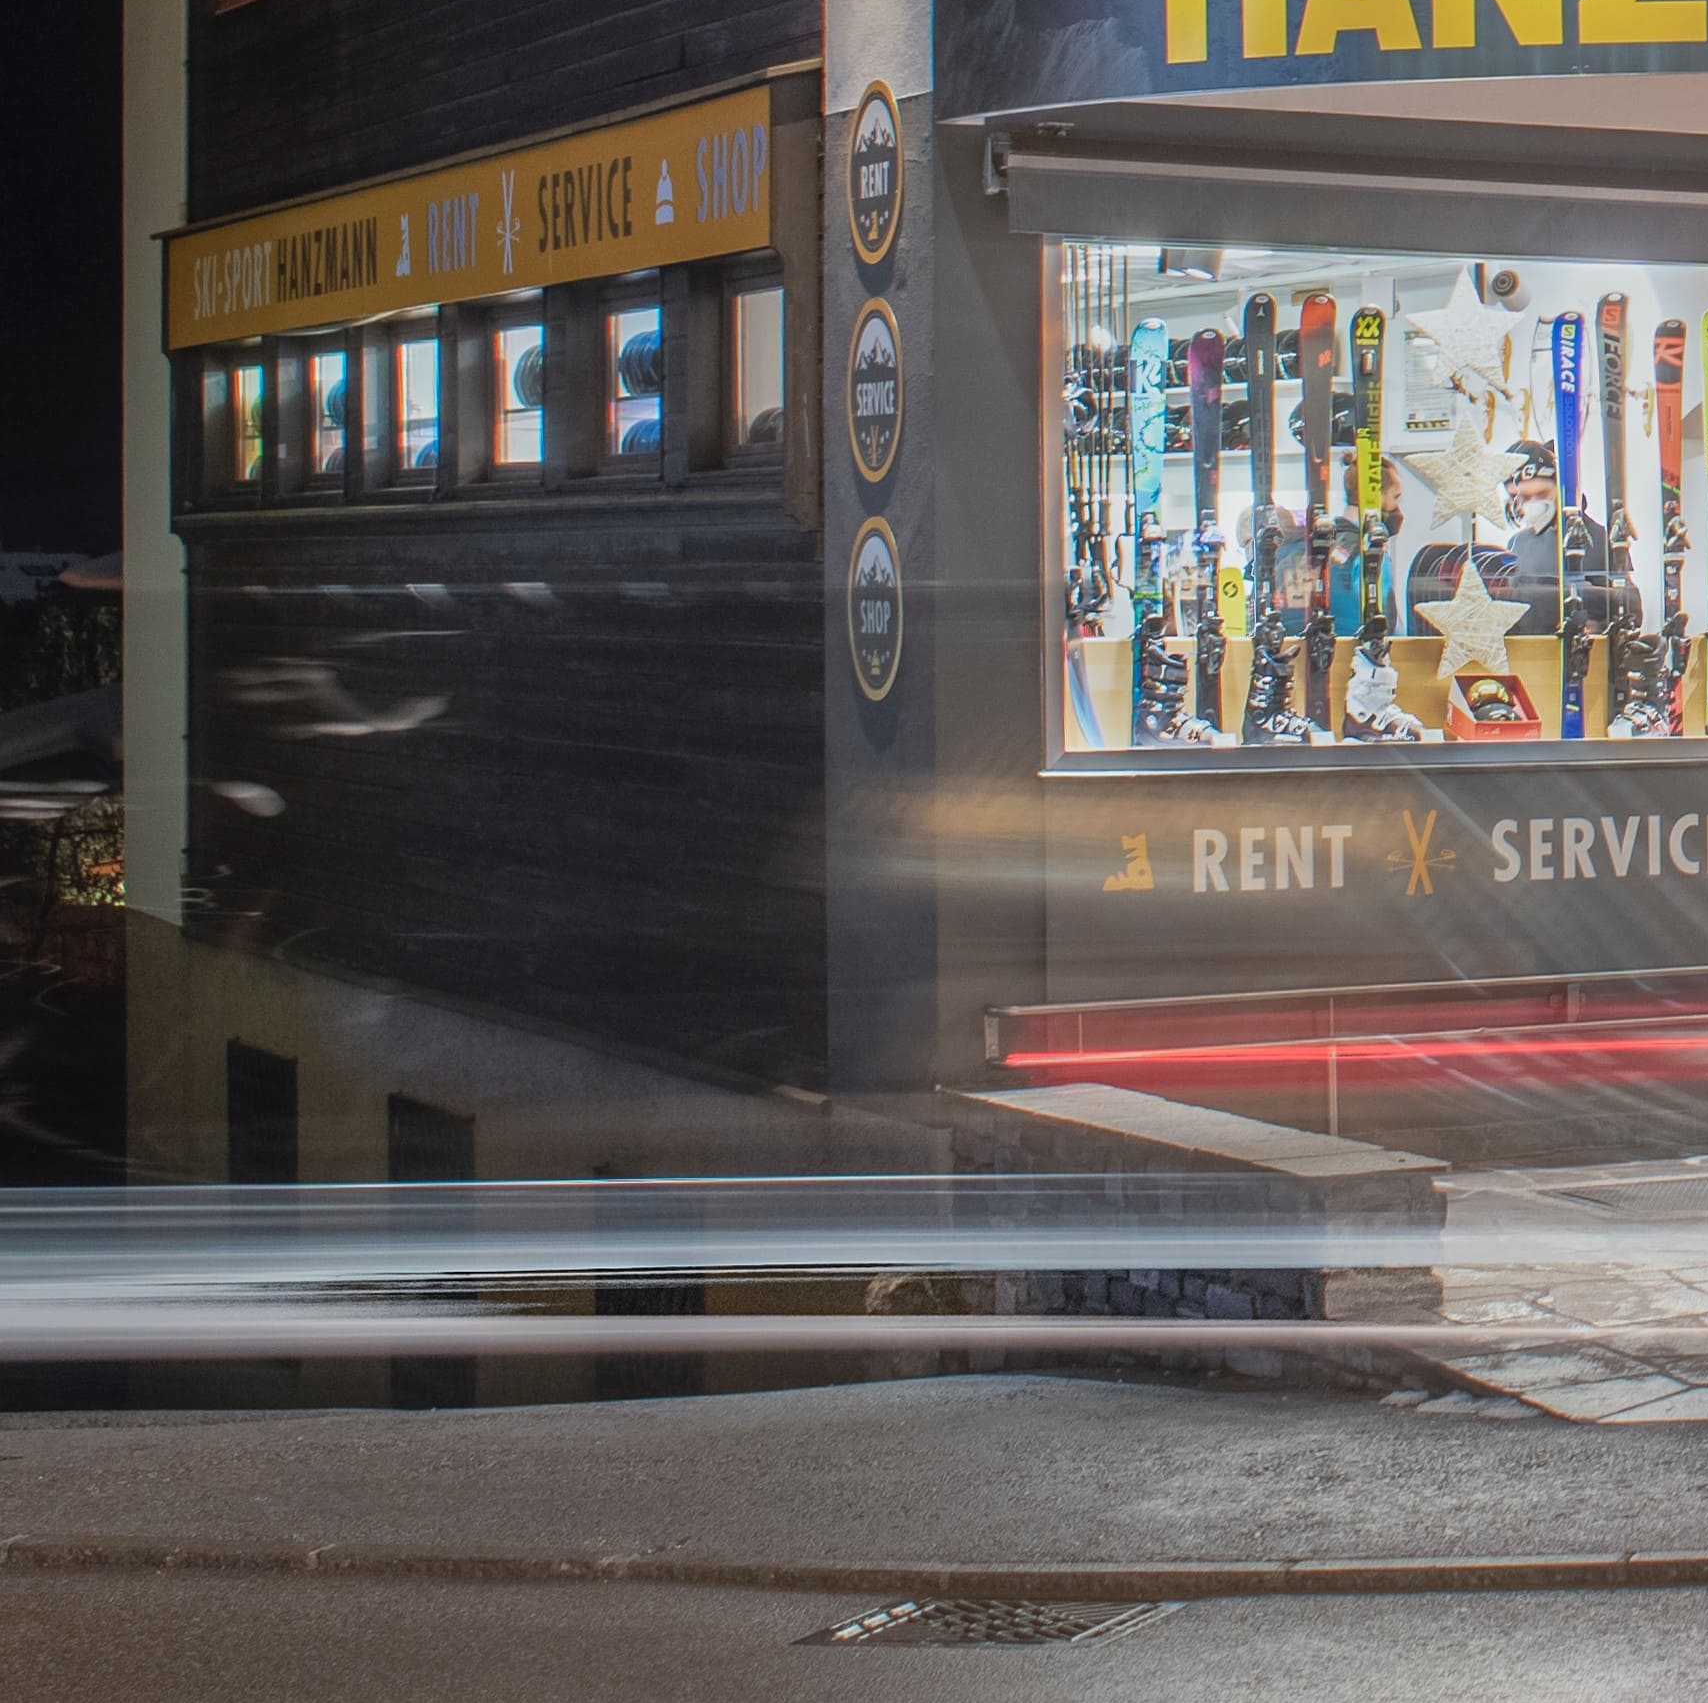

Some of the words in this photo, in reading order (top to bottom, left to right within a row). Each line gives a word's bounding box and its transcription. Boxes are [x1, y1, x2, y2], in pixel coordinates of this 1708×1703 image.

[860, 160, 890, 199] RENT
[193, 241, 273, 320] SKI-SPORT
[276, 216, 378, 303] HANZMANN
[427, 192, 479, 274] RENT
[537, 156, 633, 254] SERVICE
[696, 124, 767, 223] SHOP
[855, 379, 896, 417] SERVICE
[859, 598, 891, 636] SHOP
[1191, 823, 1353, 894] RENT
